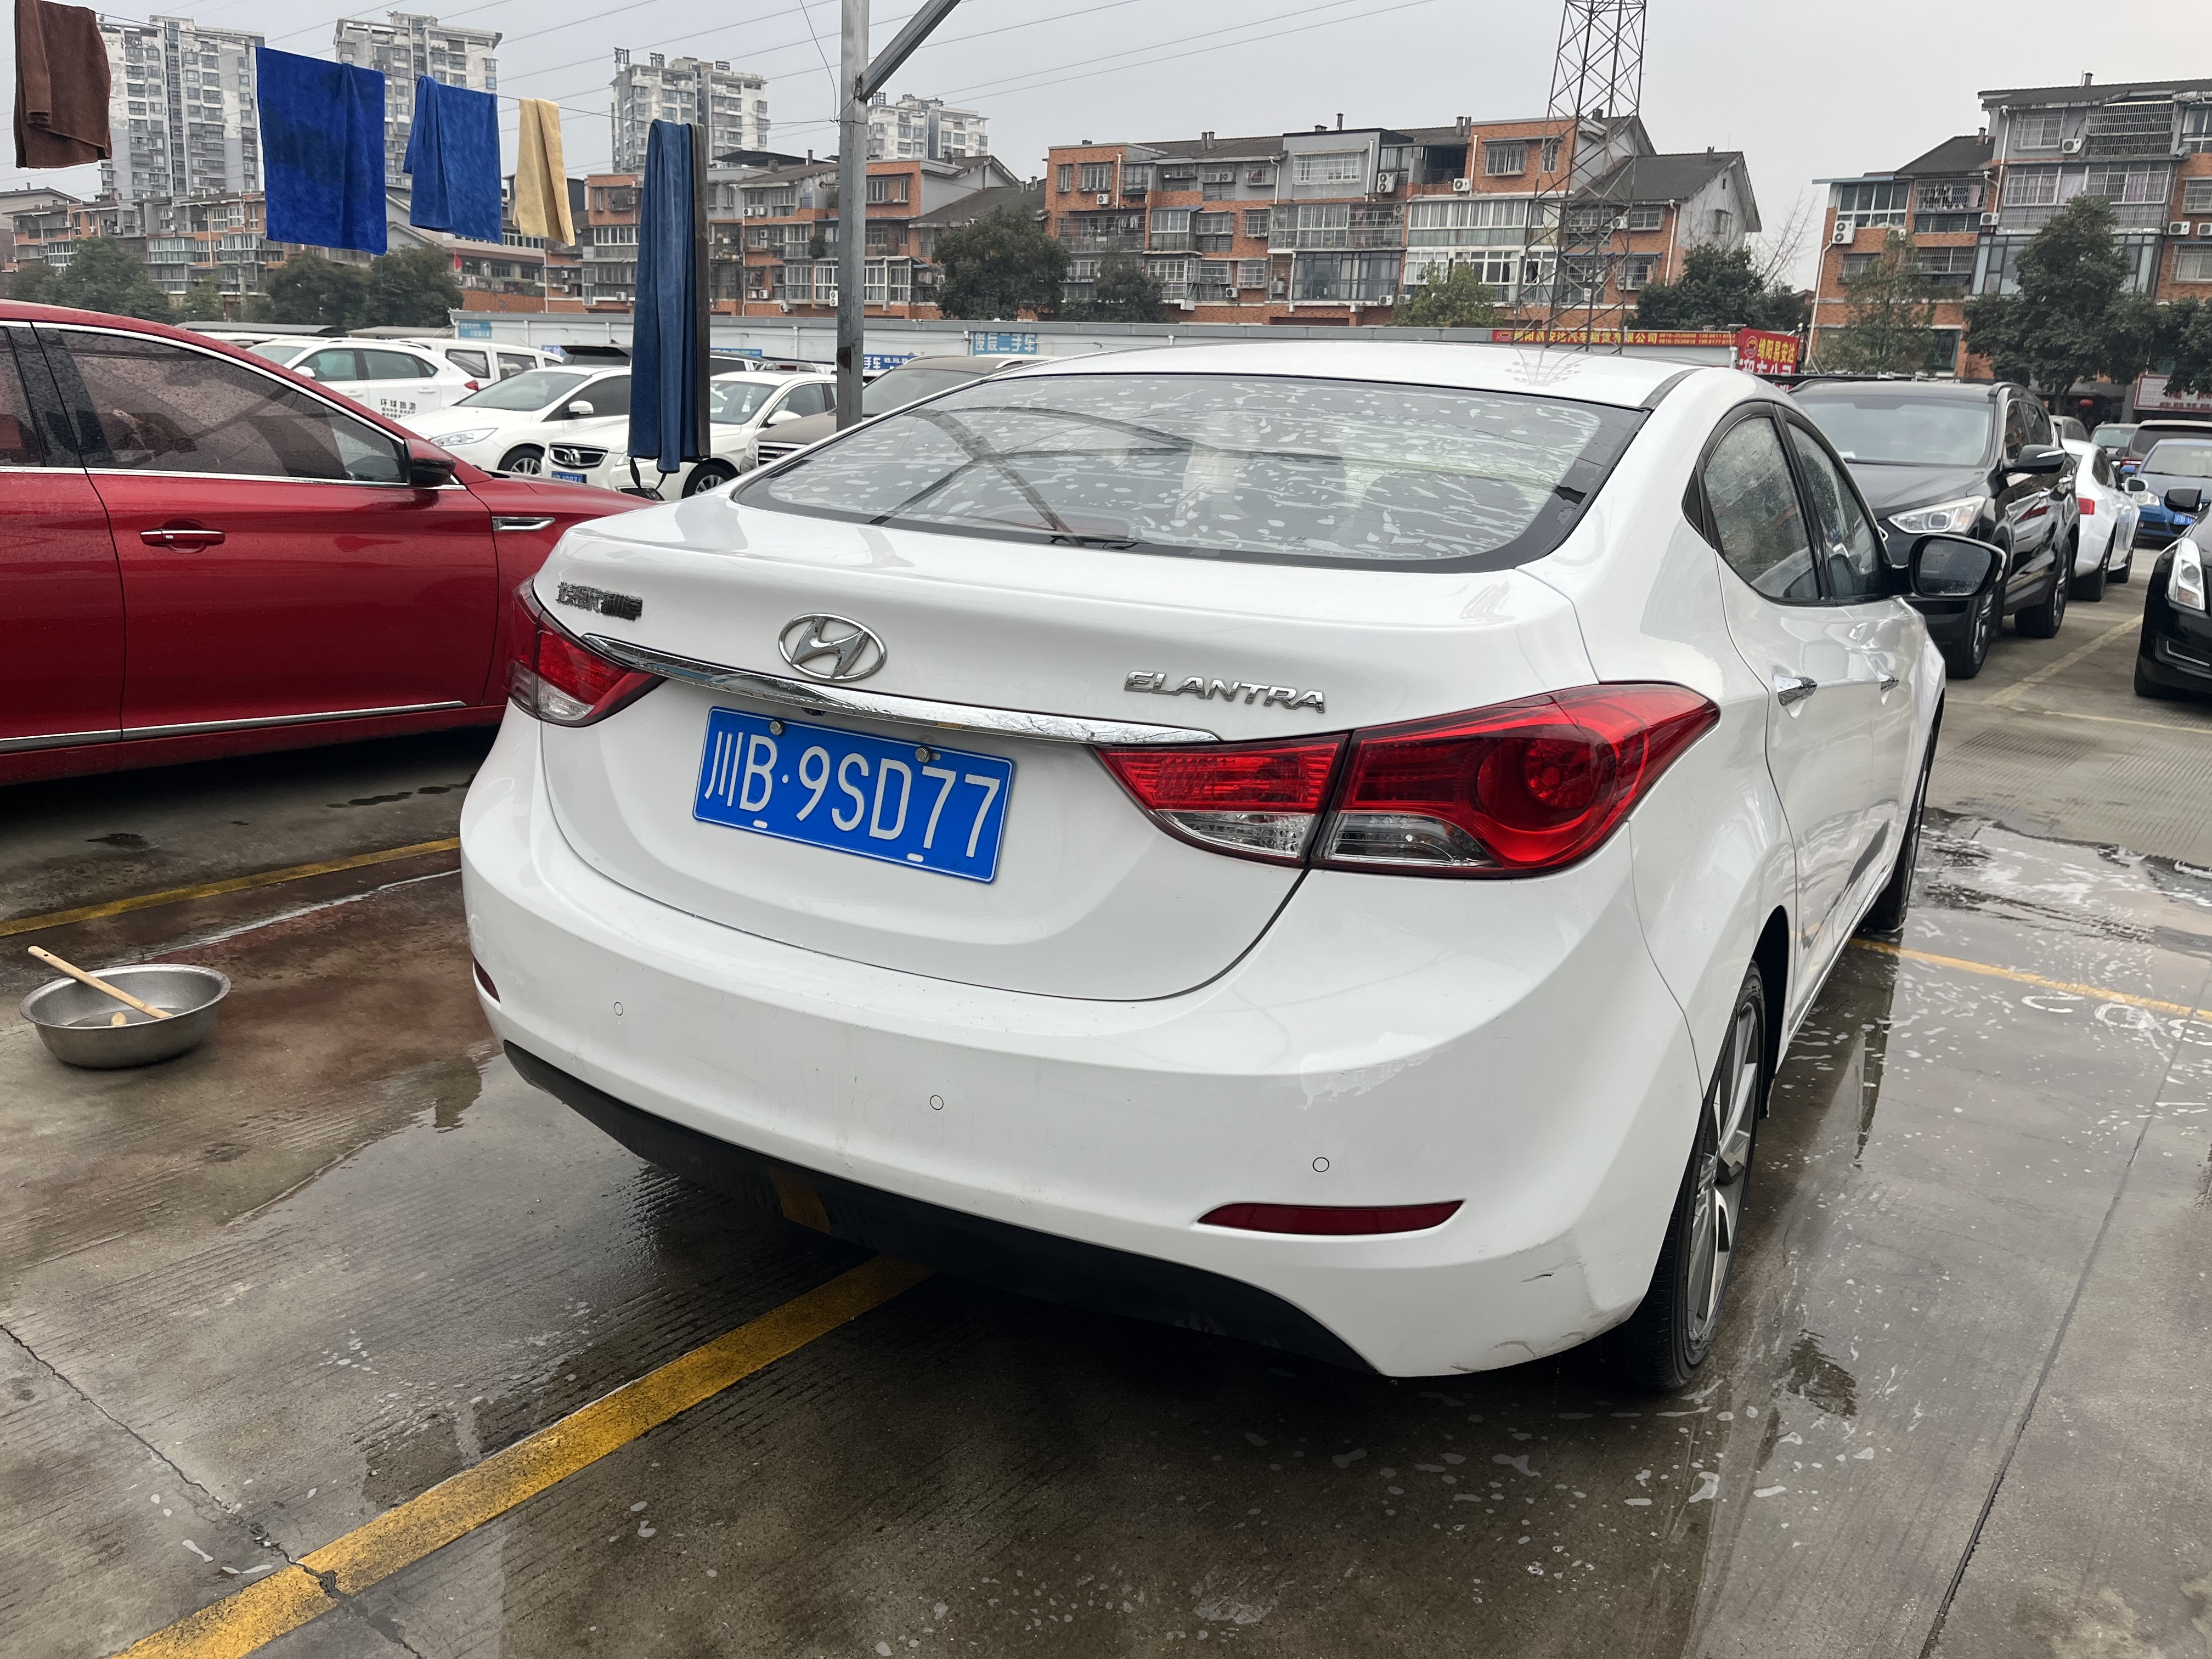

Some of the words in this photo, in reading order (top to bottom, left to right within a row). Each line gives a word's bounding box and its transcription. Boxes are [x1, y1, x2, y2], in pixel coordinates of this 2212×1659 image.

[1757, 338, 1795, 363] 绵阳易安达
[1124, 671, 1325, 713] ELANTRA
